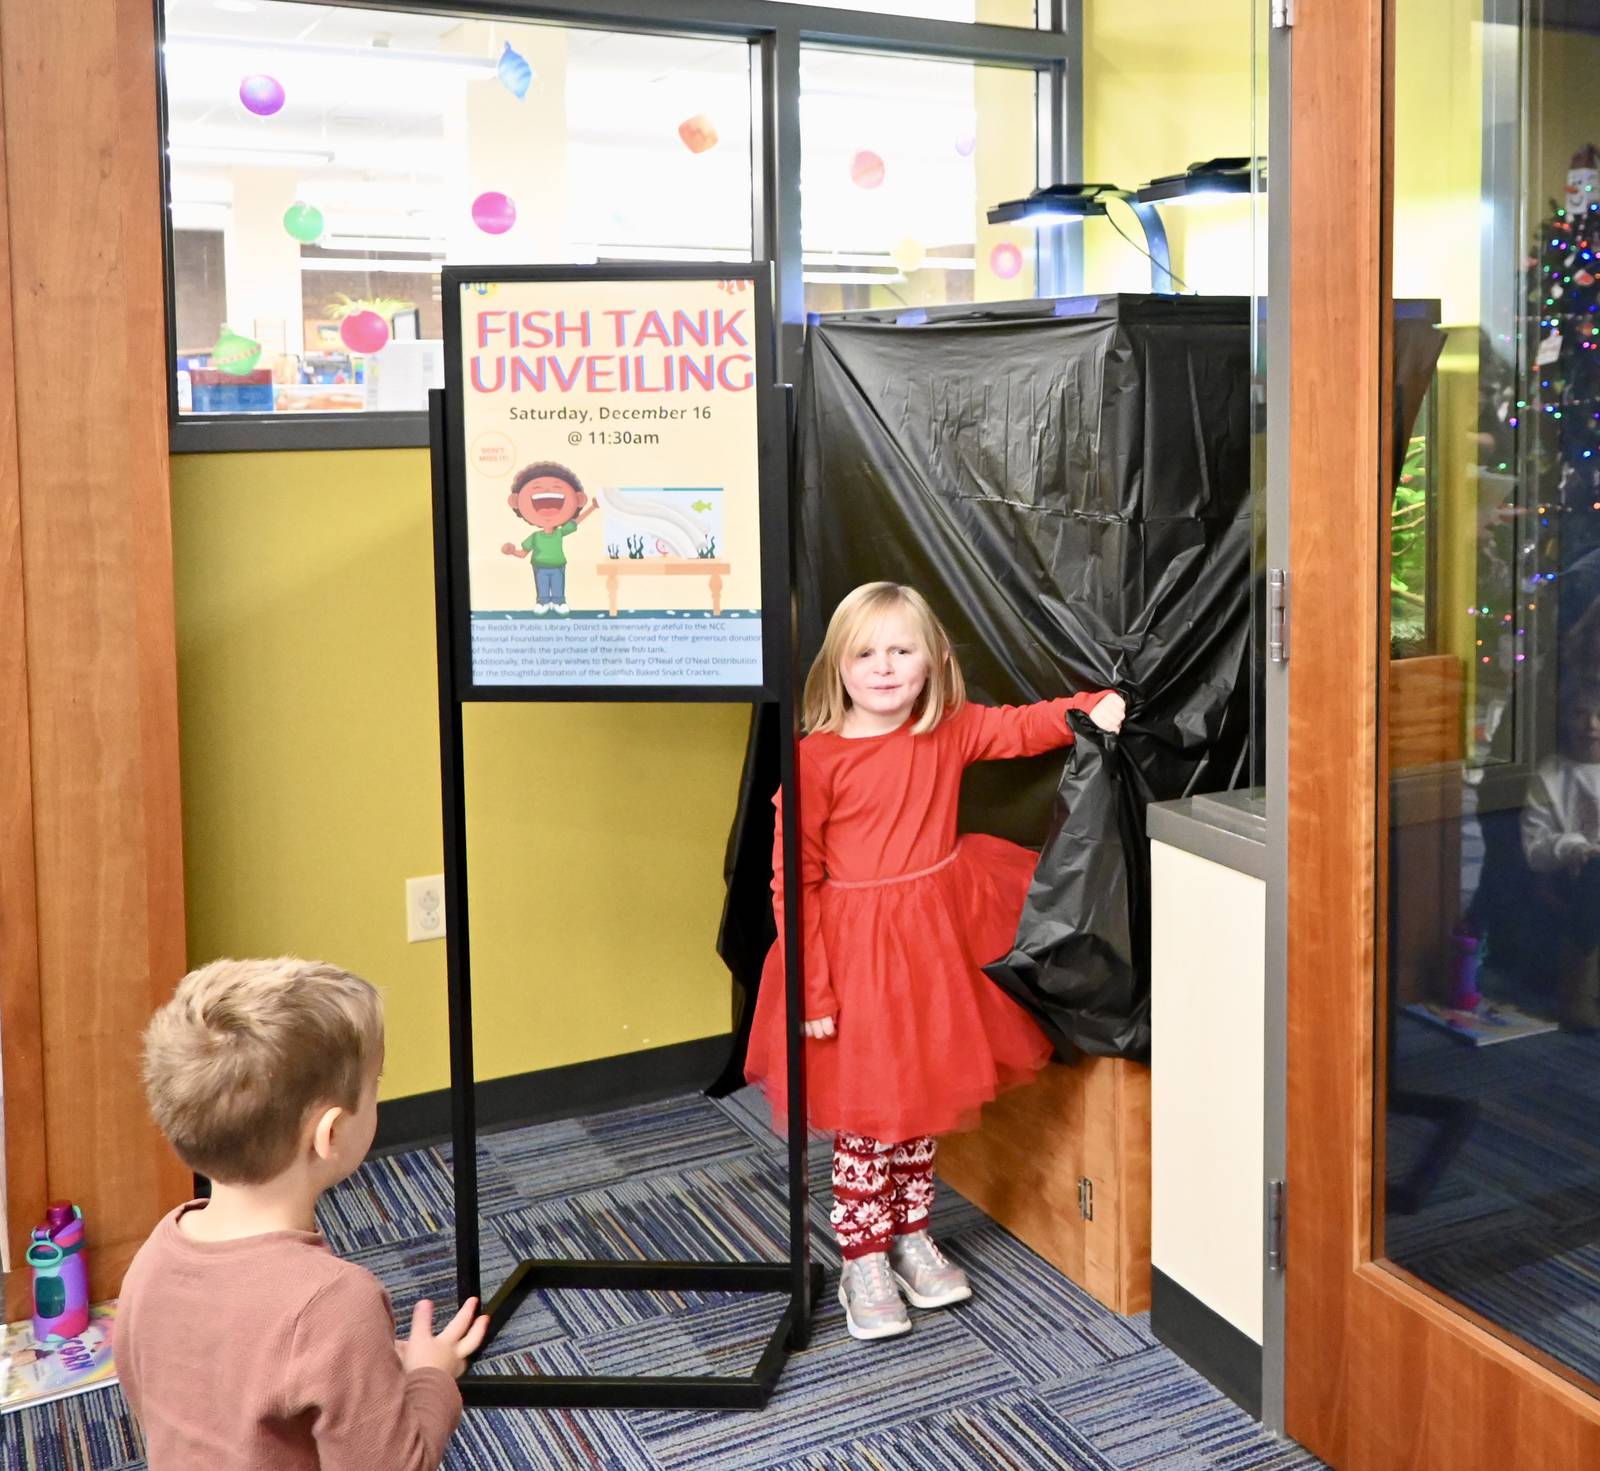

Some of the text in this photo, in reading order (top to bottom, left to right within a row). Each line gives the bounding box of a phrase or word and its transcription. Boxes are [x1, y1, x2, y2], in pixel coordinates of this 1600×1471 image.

[477, 309, 749, 349] FISH TANK
[469, 354, 754, 393] UNVEILING
[509, 406, 712, 423] Saturday, December 16
[567, 431, 660, 446] @ 11:30am
[520, 623, 542, 631] Public
[545, 623, 570, 632] Library
[573, 623, 600, 631] District
[602, 623, 608, 631] is
[653, 623, 683, 632] grateful
[658, 634, 669, 642] for
[671, 634, 689, 642] their
[691, 634, 727, 643] generous
[553, 647, 588, 655] purchase
[536, 658, 562, 666] Library
[625, 657, 646, 666] Barry
[500, 669, 541, 677] thoughtful
